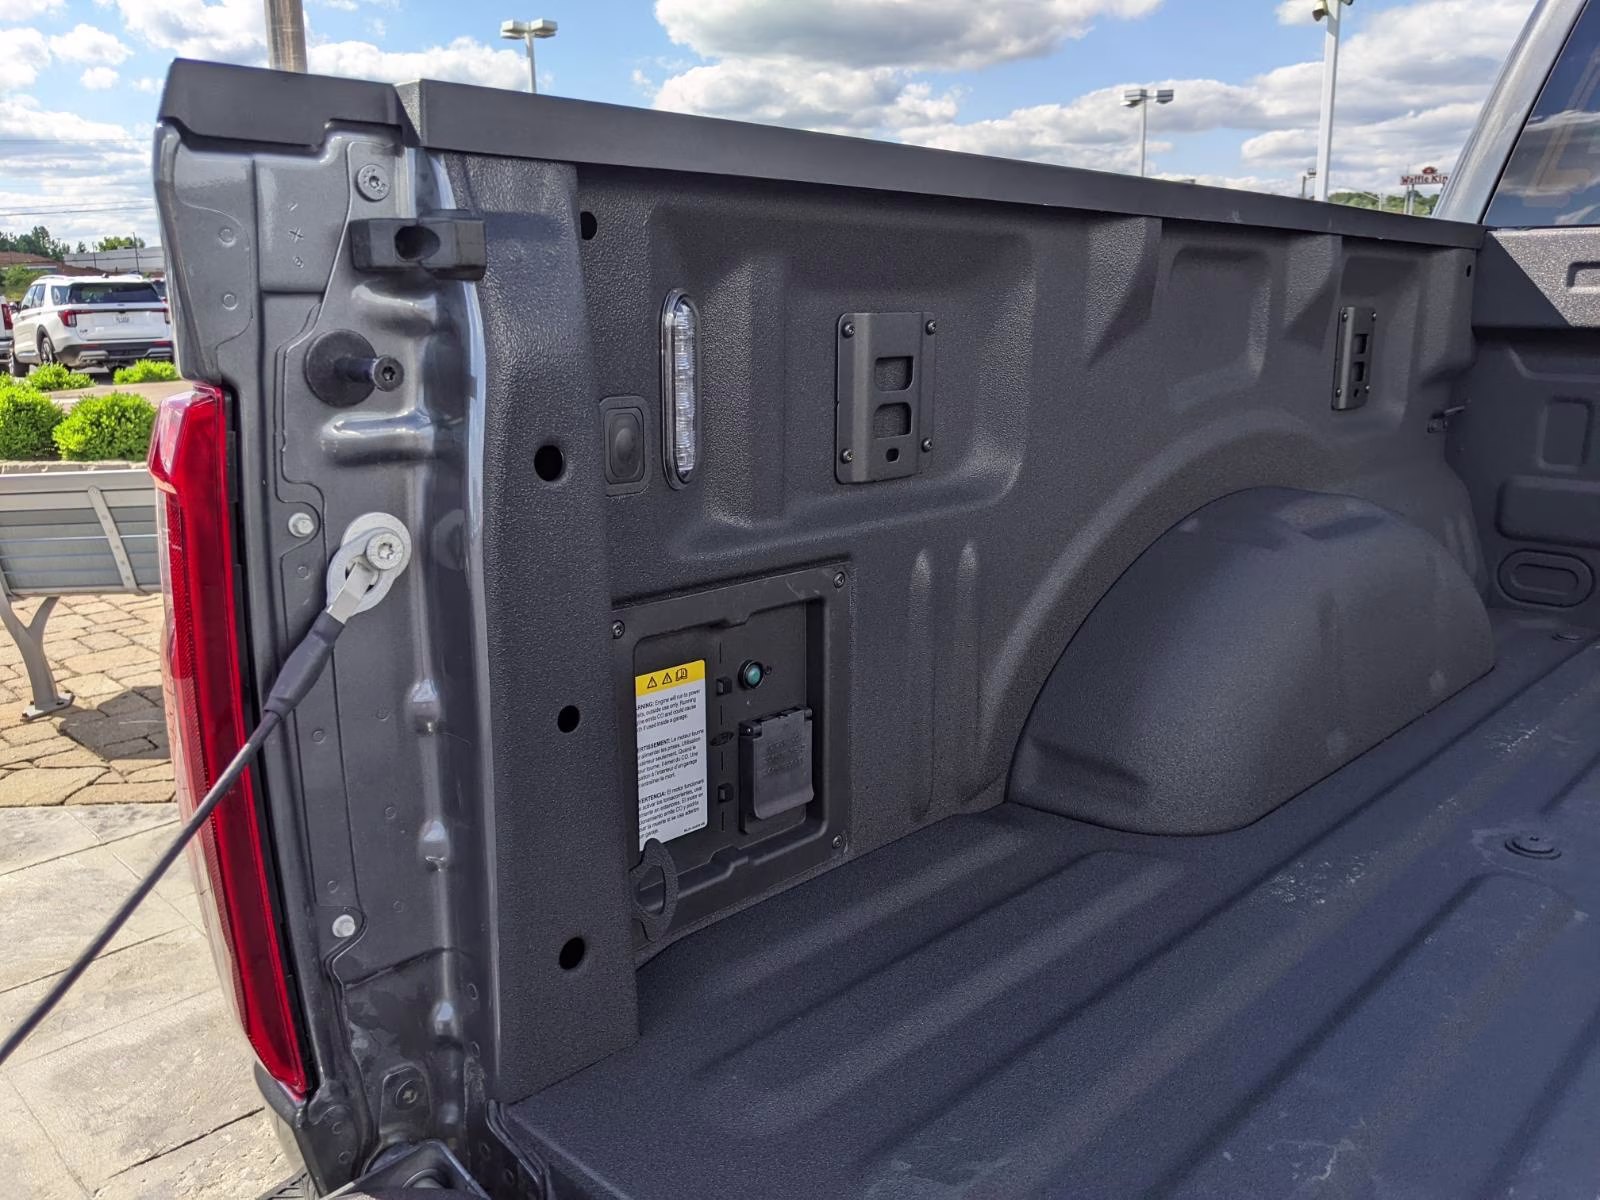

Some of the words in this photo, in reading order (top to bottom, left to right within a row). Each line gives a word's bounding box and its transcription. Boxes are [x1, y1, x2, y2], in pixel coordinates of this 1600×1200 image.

[1401, 175, 1429, 184] Waffle
[1432, 175, 1448, 184] Kin
[637, 702, 654, 710] RNING:
